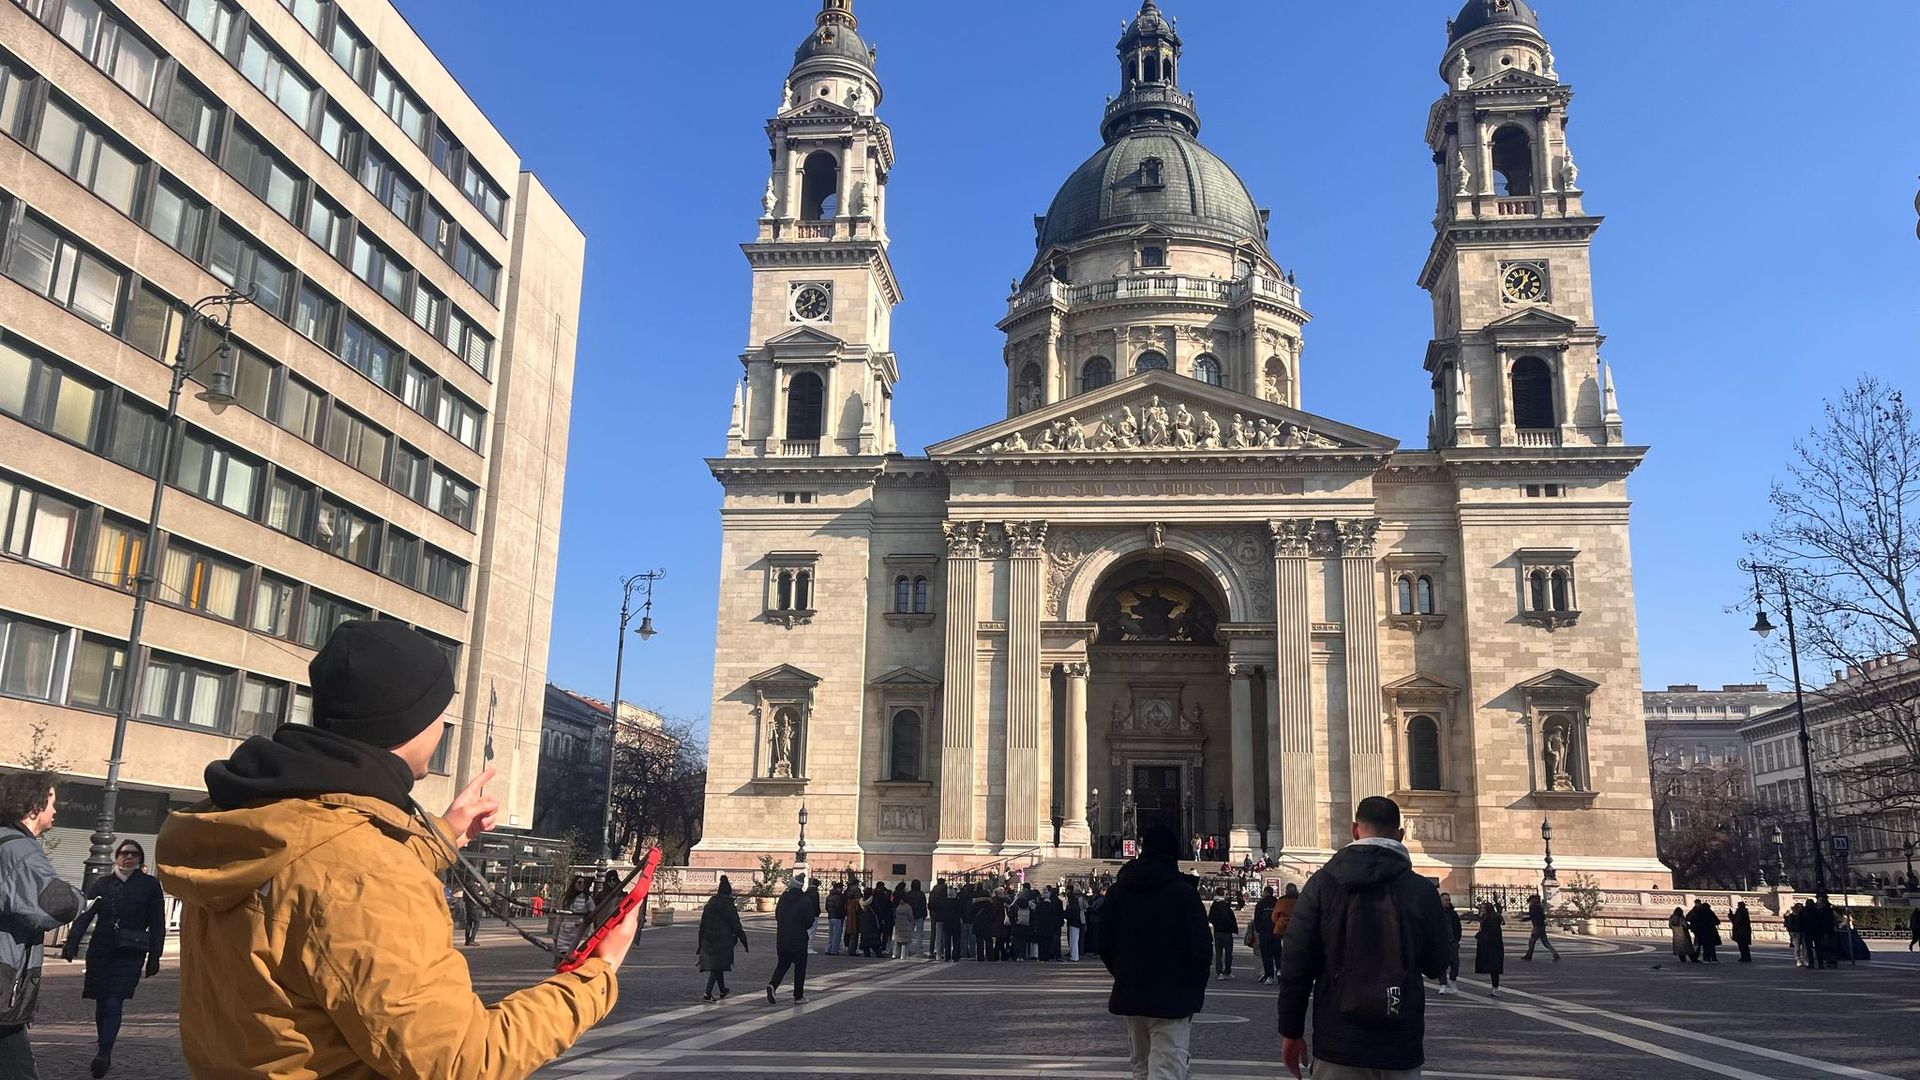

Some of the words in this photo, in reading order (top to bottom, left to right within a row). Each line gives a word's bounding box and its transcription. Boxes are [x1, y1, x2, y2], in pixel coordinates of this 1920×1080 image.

[1031, 483, 1061, 495] EGO
[1072, 483, 1104, 495] SUM
[1114, 482, 1142, 495] VIA
[1152, 482, 1215, 494] VERITAS
[1225, 482, 1243, 494] ET
[1253, 481, 1287, 494] VITA
